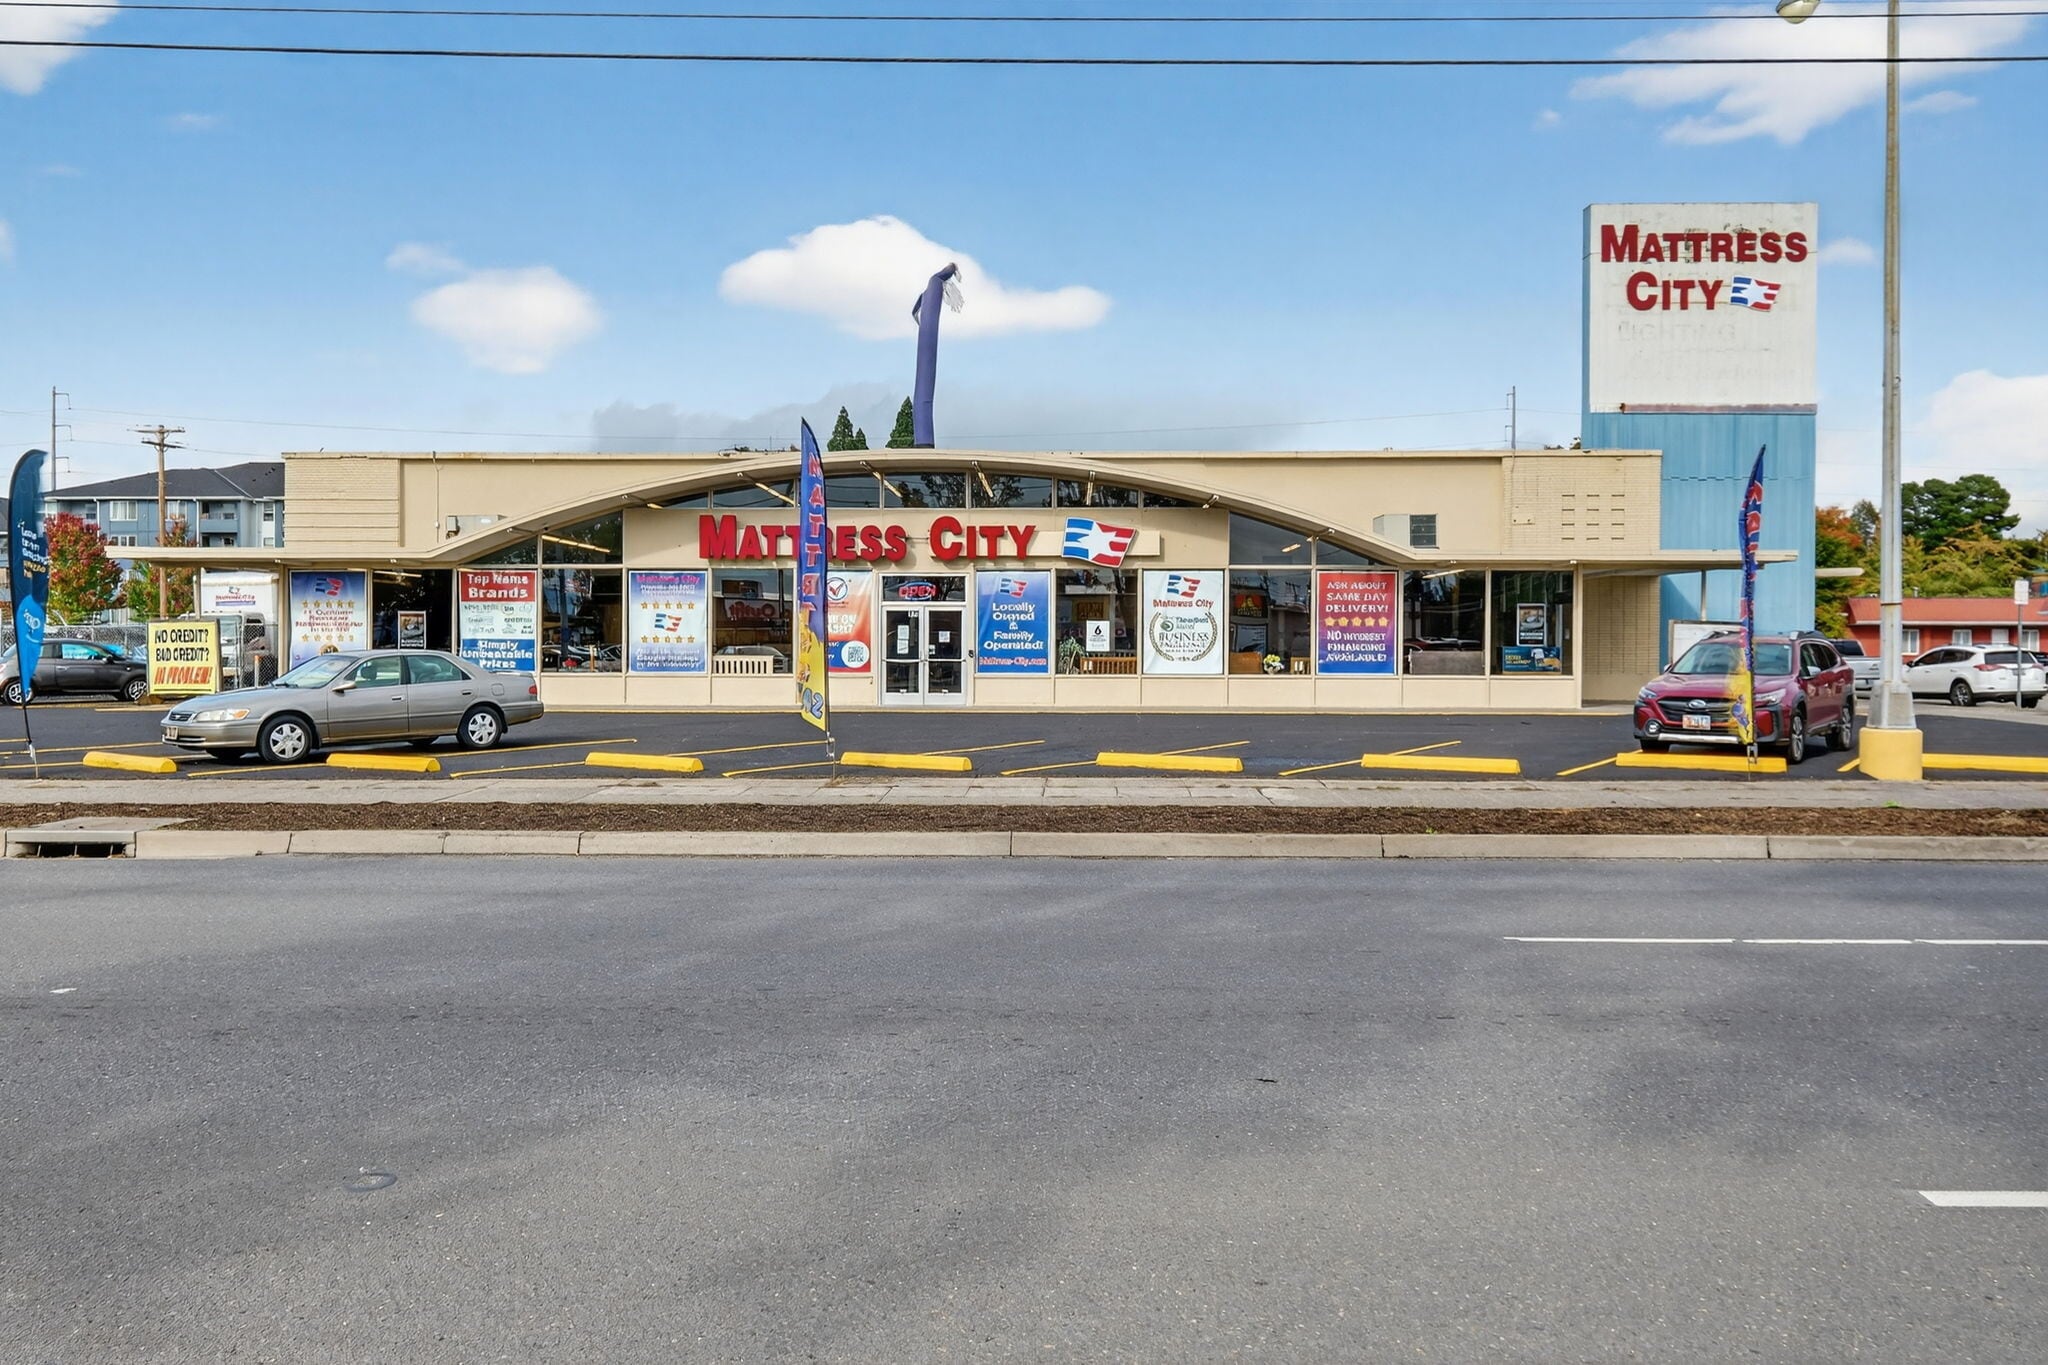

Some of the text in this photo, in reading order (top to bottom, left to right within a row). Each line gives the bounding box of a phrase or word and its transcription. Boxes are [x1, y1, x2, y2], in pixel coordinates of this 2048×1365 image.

[1601, 225, 1807, 263] MATTRESS
[1626, 271, 1723, 311] CITY
[929, 515, 1036, 561] CITY
[468, 587, 528, 598] Brands
[898, 584, 937, 597] OPEN
[1364, 592, 1388, 601] DAY
[992, 602, 1035, 612] Locally
[1325, 604, 1388, 613] DELIVERY!
